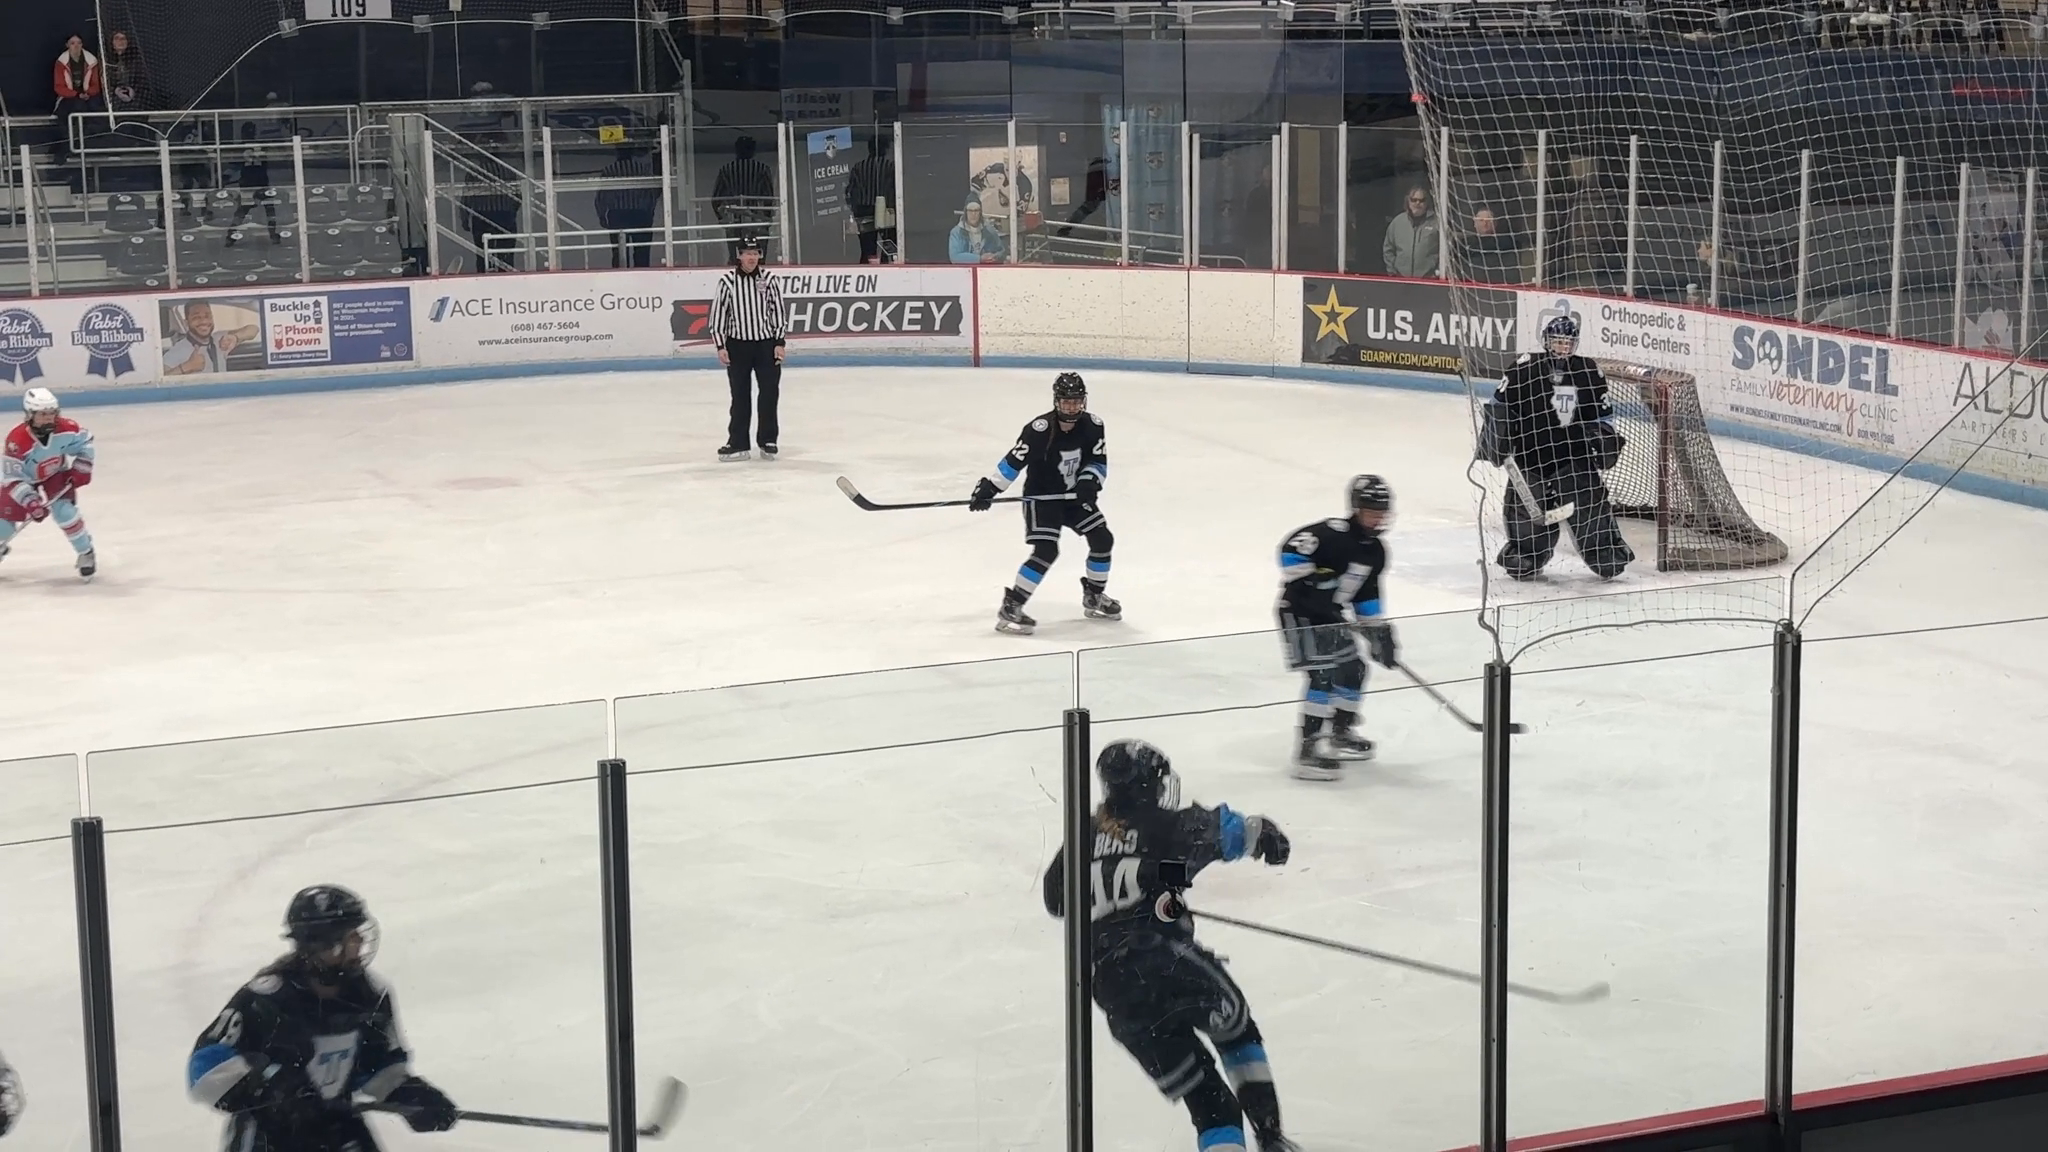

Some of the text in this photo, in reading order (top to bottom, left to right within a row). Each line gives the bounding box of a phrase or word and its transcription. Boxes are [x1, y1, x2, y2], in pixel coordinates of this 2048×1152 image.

[331, 0, 367, 17] 109
[814, 164, 850, 179] ICE CREAM
[781, 274, 878, 294] TCH LIVE ON
[270, 301, 311, 312] Buckle
[450, 293, 663, 318] ACE Insurance Group
[89, 311, 125, 330] Pabst
[294, 313, 311, 324] Up
[510, 321, 580, 332] (608) 467-5604
[788, 301, 953, 333] HOCKEY
[1601, 304, 1687, 331] Orthopedic &
[72, 329, 142, 345] Blue Ribbon
[285, 325, 323, 336] Phone
[1366, 307, 1516, 351] U.S. ARMY
[9, 335, 51, 349] Ribbon
[285, 336, 321, 347] Down
[478, 333, 613, 346] www.aceinsurancegroup.com
[1600, 327, 1692, 356] Spine Centers
[1731, 325, 1899, 397] SONDEL
[1952, 362, 2048, 425] ALD
[1555, 394, 1575, 413] T
[1730, 378, 1899, 437] FAMILY veterinary CLINIC
[1951, 418, 2029, 444] ARTNERS
[1011, 439, 1031, 462] 22
[1062, 457, 1080, 477] T
